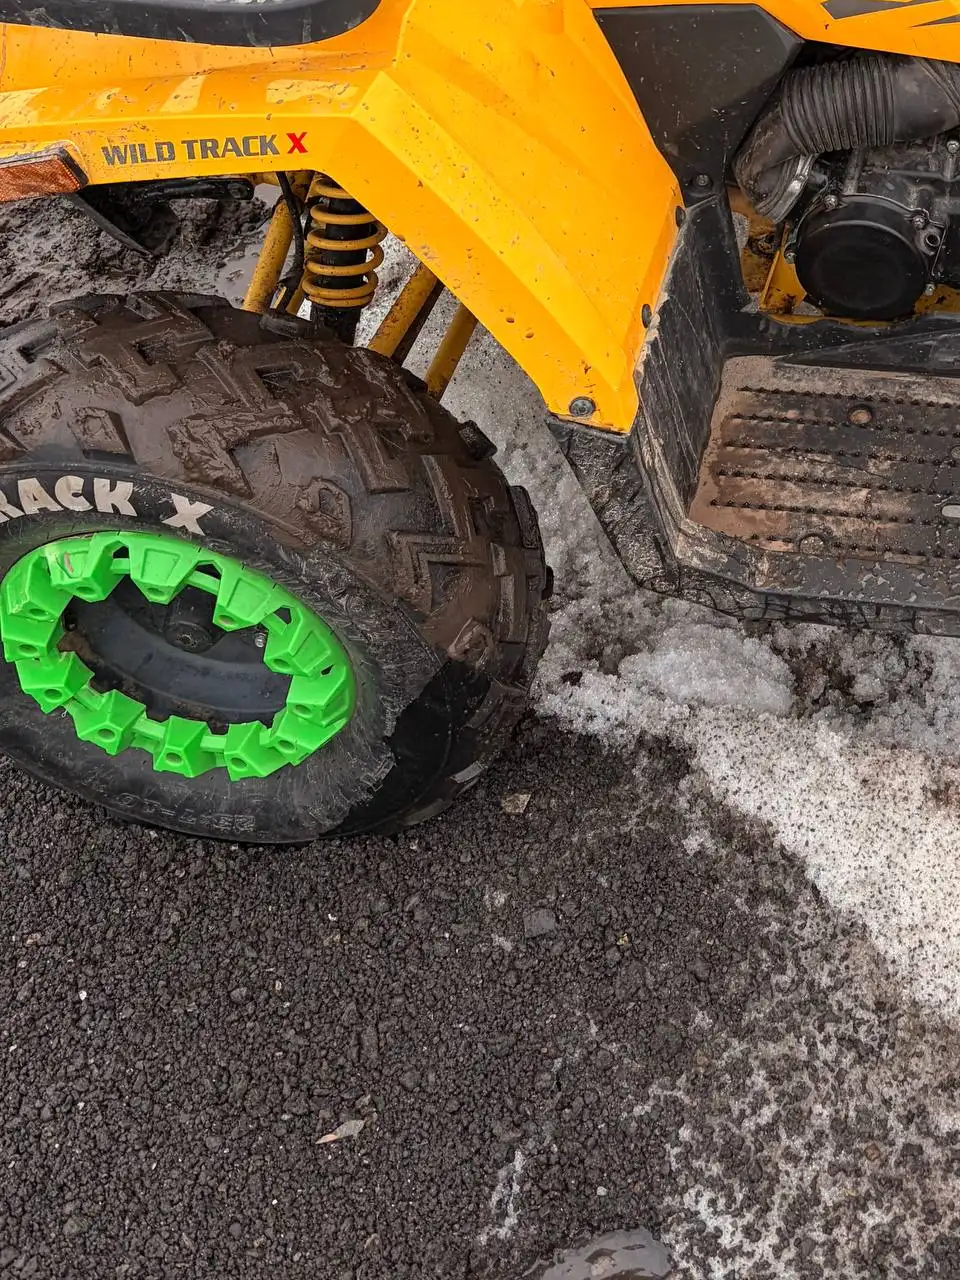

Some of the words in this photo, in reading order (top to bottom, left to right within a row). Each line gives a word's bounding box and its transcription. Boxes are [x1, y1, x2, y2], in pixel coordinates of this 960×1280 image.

[101, 140, 176, 166] WILD
[181, 134, 280, 160] TRACK
[286, 131, 309, 154] X
[161, 492, 215, 536] X
